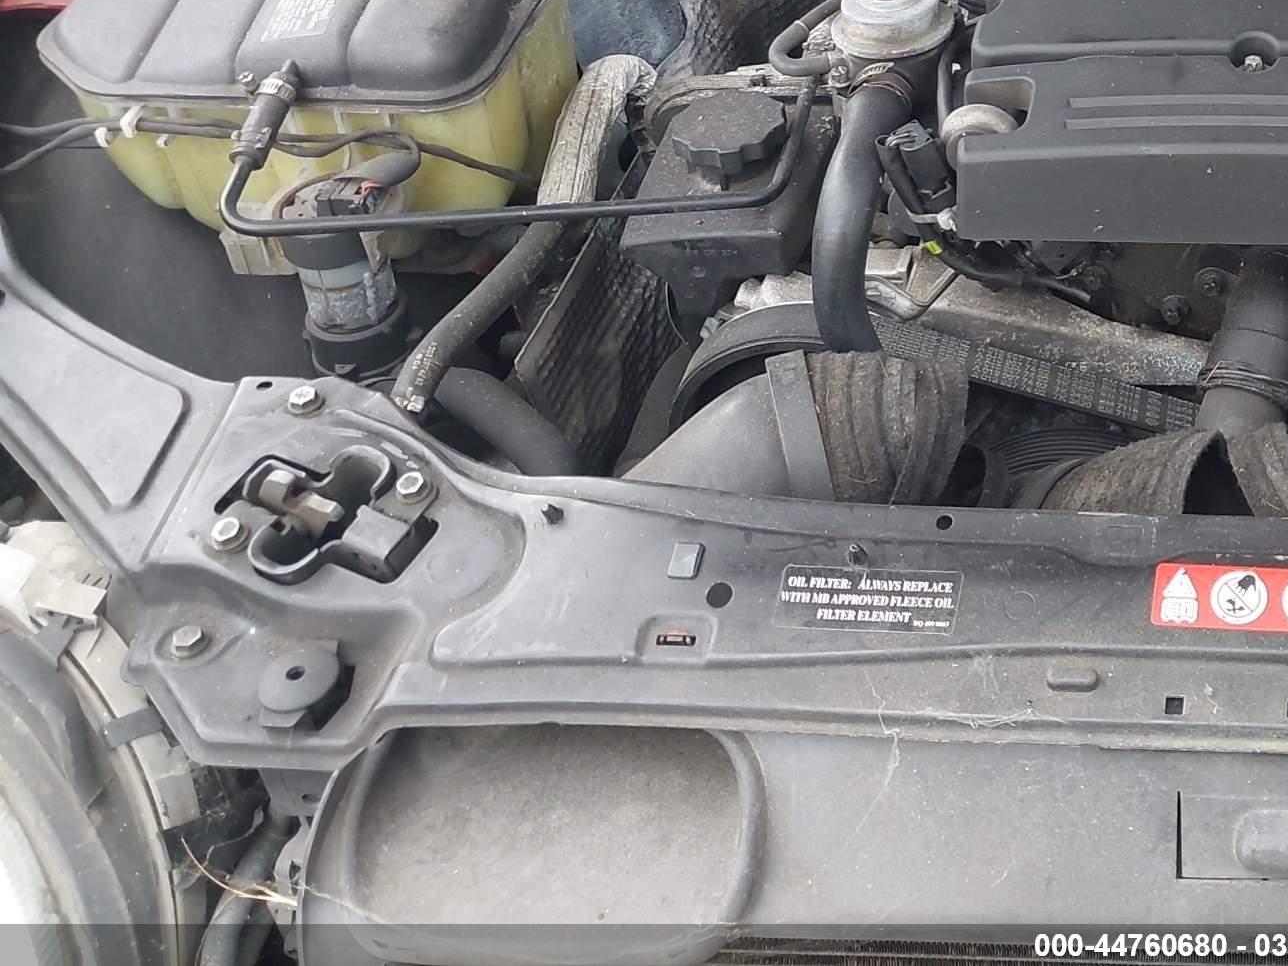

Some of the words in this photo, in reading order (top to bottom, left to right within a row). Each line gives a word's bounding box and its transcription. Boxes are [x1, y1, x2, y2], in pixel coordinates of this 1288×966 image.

[788, 576, 808, 589] OIL
[809, 577, 852, 590] FILTER:
[857, 578, 901, 592] ALWAYS
[902, 580, 954, 594] REPLACE
[781, 591, 811, 604] WITH
[812, 592, 830, 604] MB
[831, 594, 889, 607] APPROVED
[890, 596, 933, 609] FLEECE
[934, 598, 954, 609] OIL
[816, 608, 856, 621] FILTER
[857, 610, 912, 624] ELEMENT
